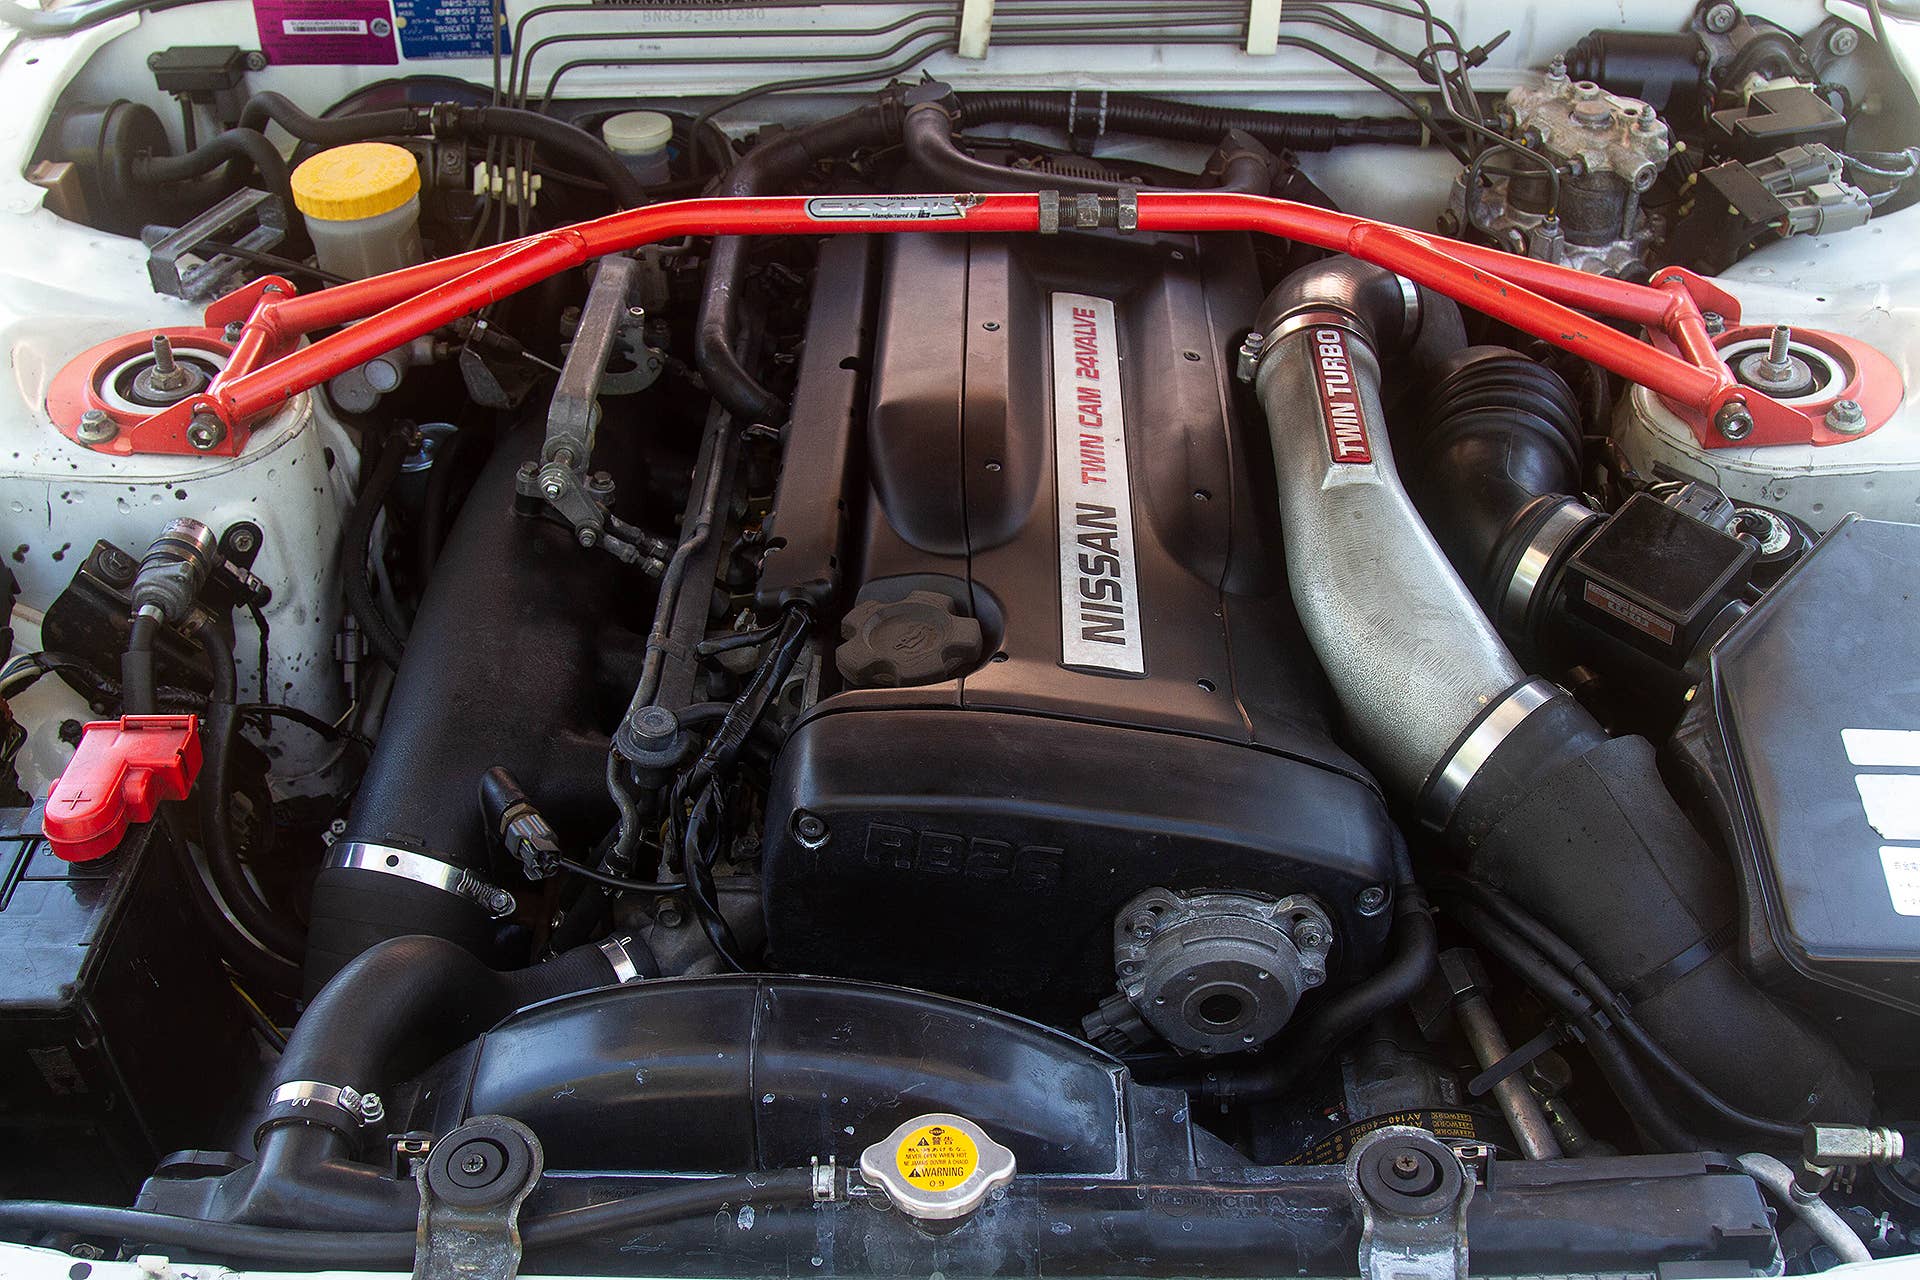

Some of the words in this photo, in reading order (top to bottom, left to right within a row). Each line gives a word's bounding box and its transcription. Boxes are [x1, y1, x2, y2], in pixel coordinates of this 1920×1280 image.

[1072, 306, 1098, 381] 24VALVE
[1316, 329, 1352, 398] TURBO
[1078, 386, 1105, 430] CAM
[1330, 402, 1365, 457] TWIN
[1081, 433, 1107, 486] TWIN
[1075, 502, 1126, 647] NISSAN
[922, 1166, 964, 1177] WARNING
